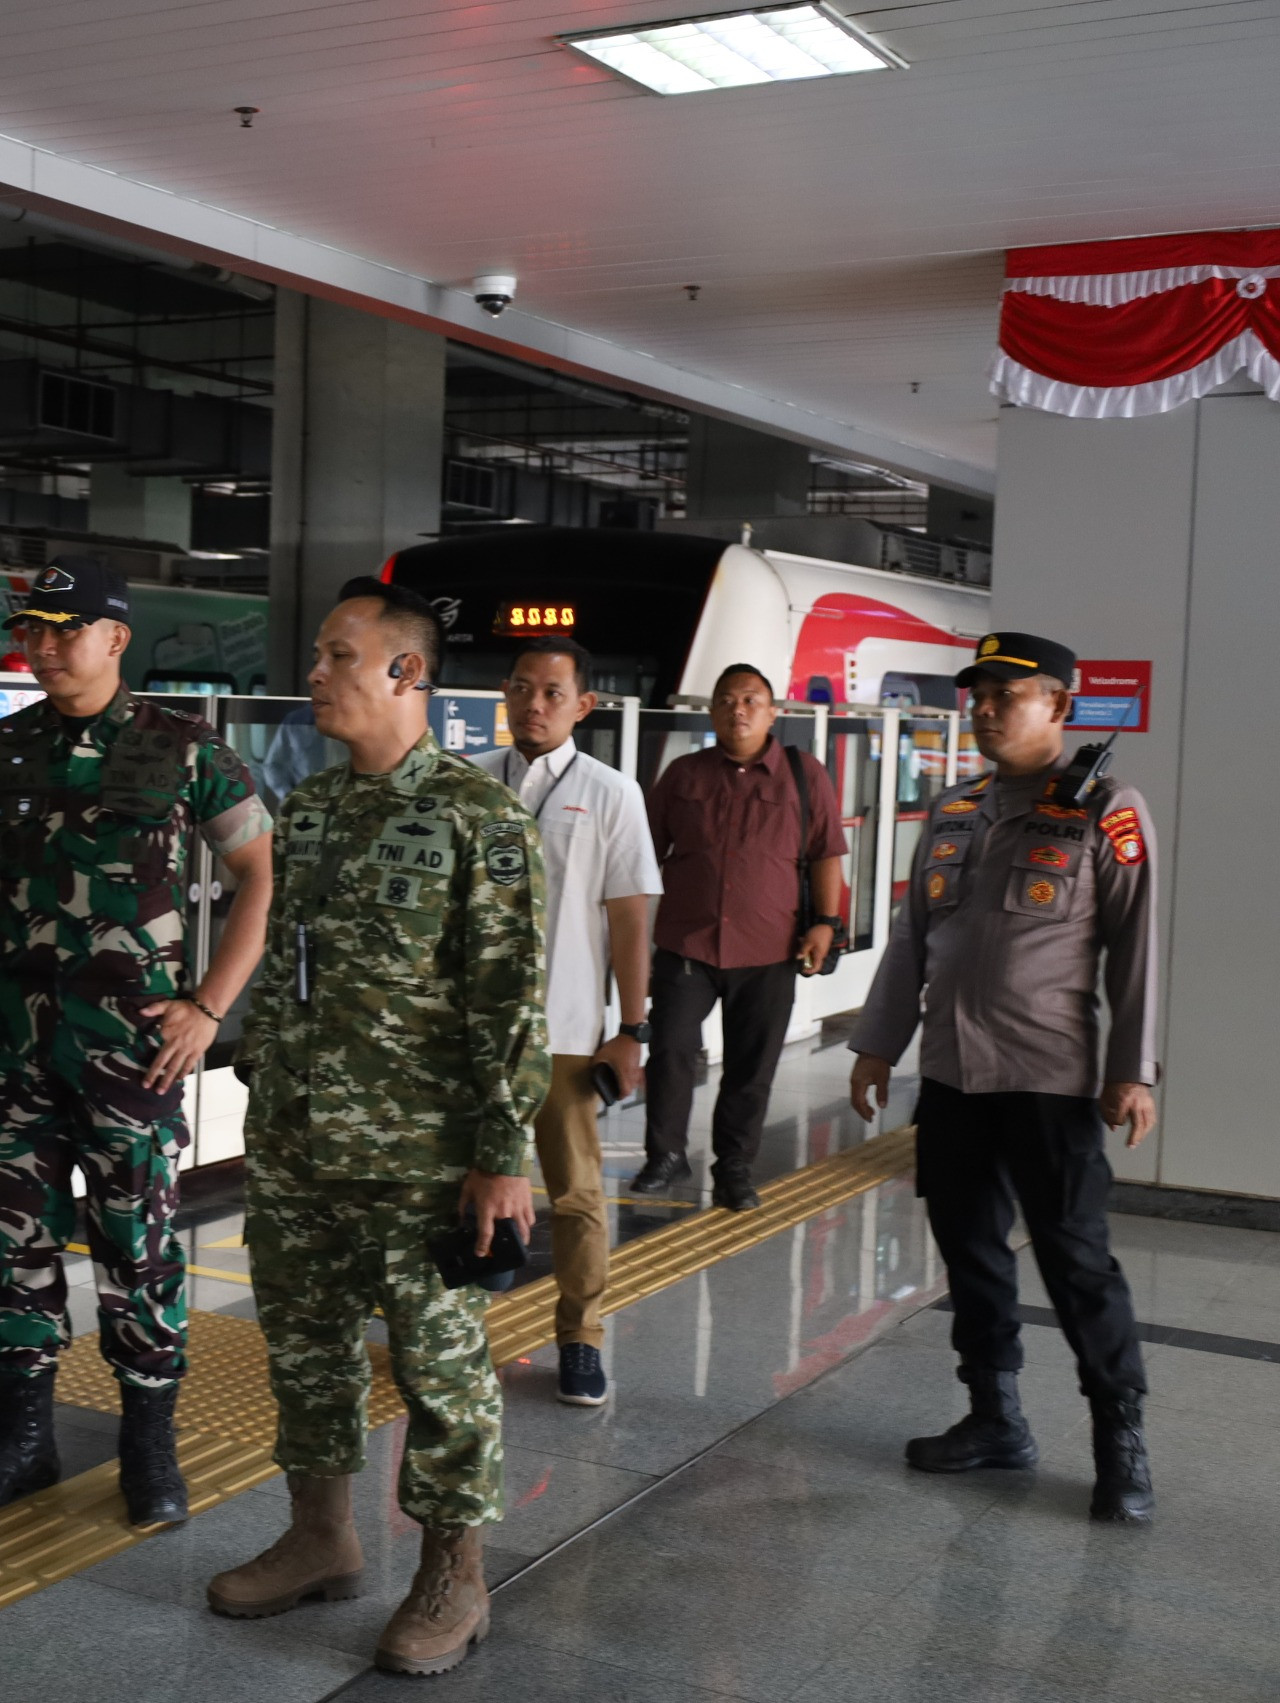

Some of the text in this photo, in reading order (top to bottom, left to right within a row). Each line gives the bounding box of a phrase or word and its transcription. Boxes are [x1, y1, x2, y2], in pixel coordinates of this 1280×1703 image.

[1023, 821, 1086, 842] POLRI
[376, 842, 443, 869] TNI AD
